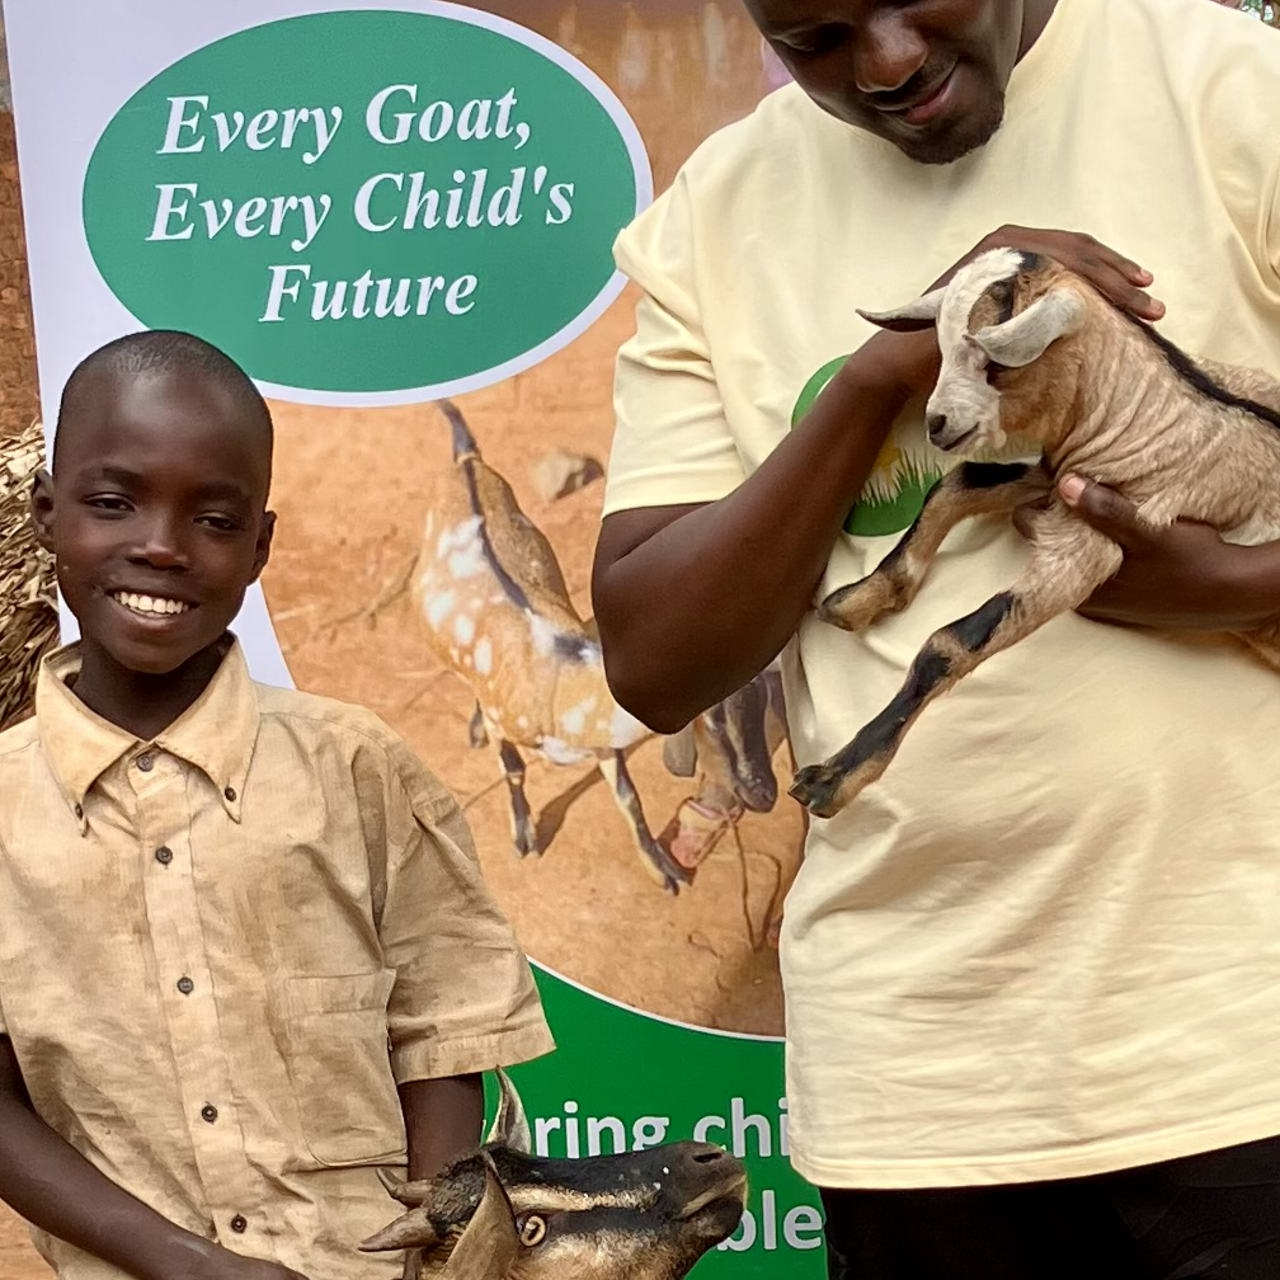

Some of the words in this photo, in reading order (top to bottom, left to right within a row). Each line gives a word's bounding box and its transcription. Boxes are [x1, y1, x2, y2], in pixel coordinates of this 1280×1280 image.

[156, 93, 343, 164] Every
[365, 83, 531, 150] Goat,
[145, 182, 331, 251] Every
[354, 165, 575, 232] Child's
[258, 264, 478, 323] Future
